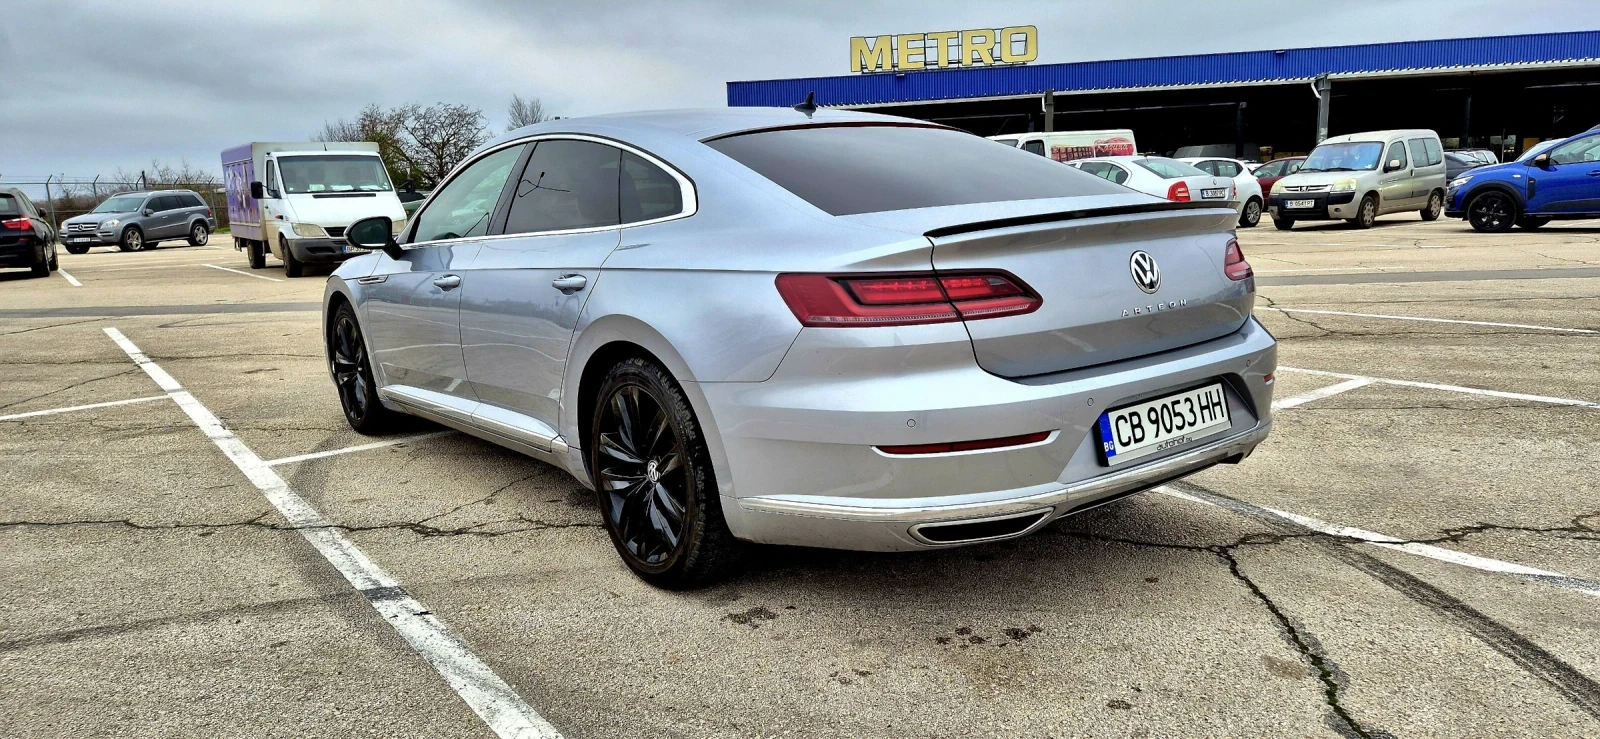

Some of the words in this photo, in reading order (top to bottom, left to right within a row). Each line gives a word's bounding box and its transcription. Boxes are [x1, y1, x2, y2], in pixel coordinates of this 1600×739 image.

[850, 25, 1039, 73] METRO
[1121, 299, 1187, 317] ARTEON
[1115, 411, 1145, 447] CB
[1147, 397, 1197, 438] 9053
[1197, 388, 1224, 424] HH
[1104, 441, 1115, 452] BG
